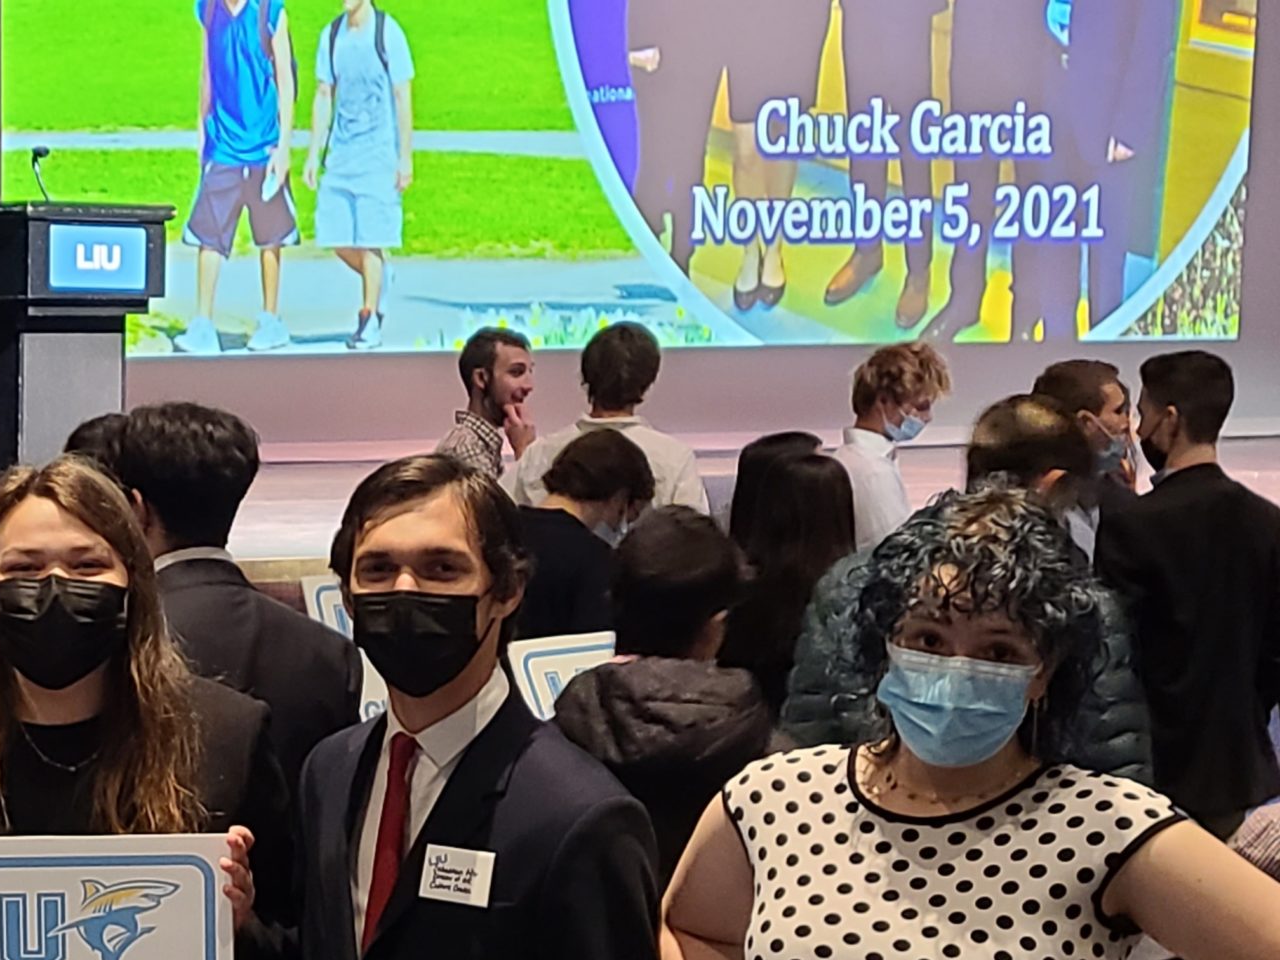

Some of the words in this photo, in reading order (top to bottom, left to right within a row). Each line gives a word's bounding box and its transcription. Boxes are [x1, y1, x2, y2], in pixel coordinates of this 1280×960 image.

[756, 97, 900, 156] Chuck
[910, 99, 1053, 157] Garcia
[691, 181, 931, 241] November
[942, 182, 982, 247] 5,
[994, 184, 1105, 239] 2021
[75, 243, 121, 271] LIU
